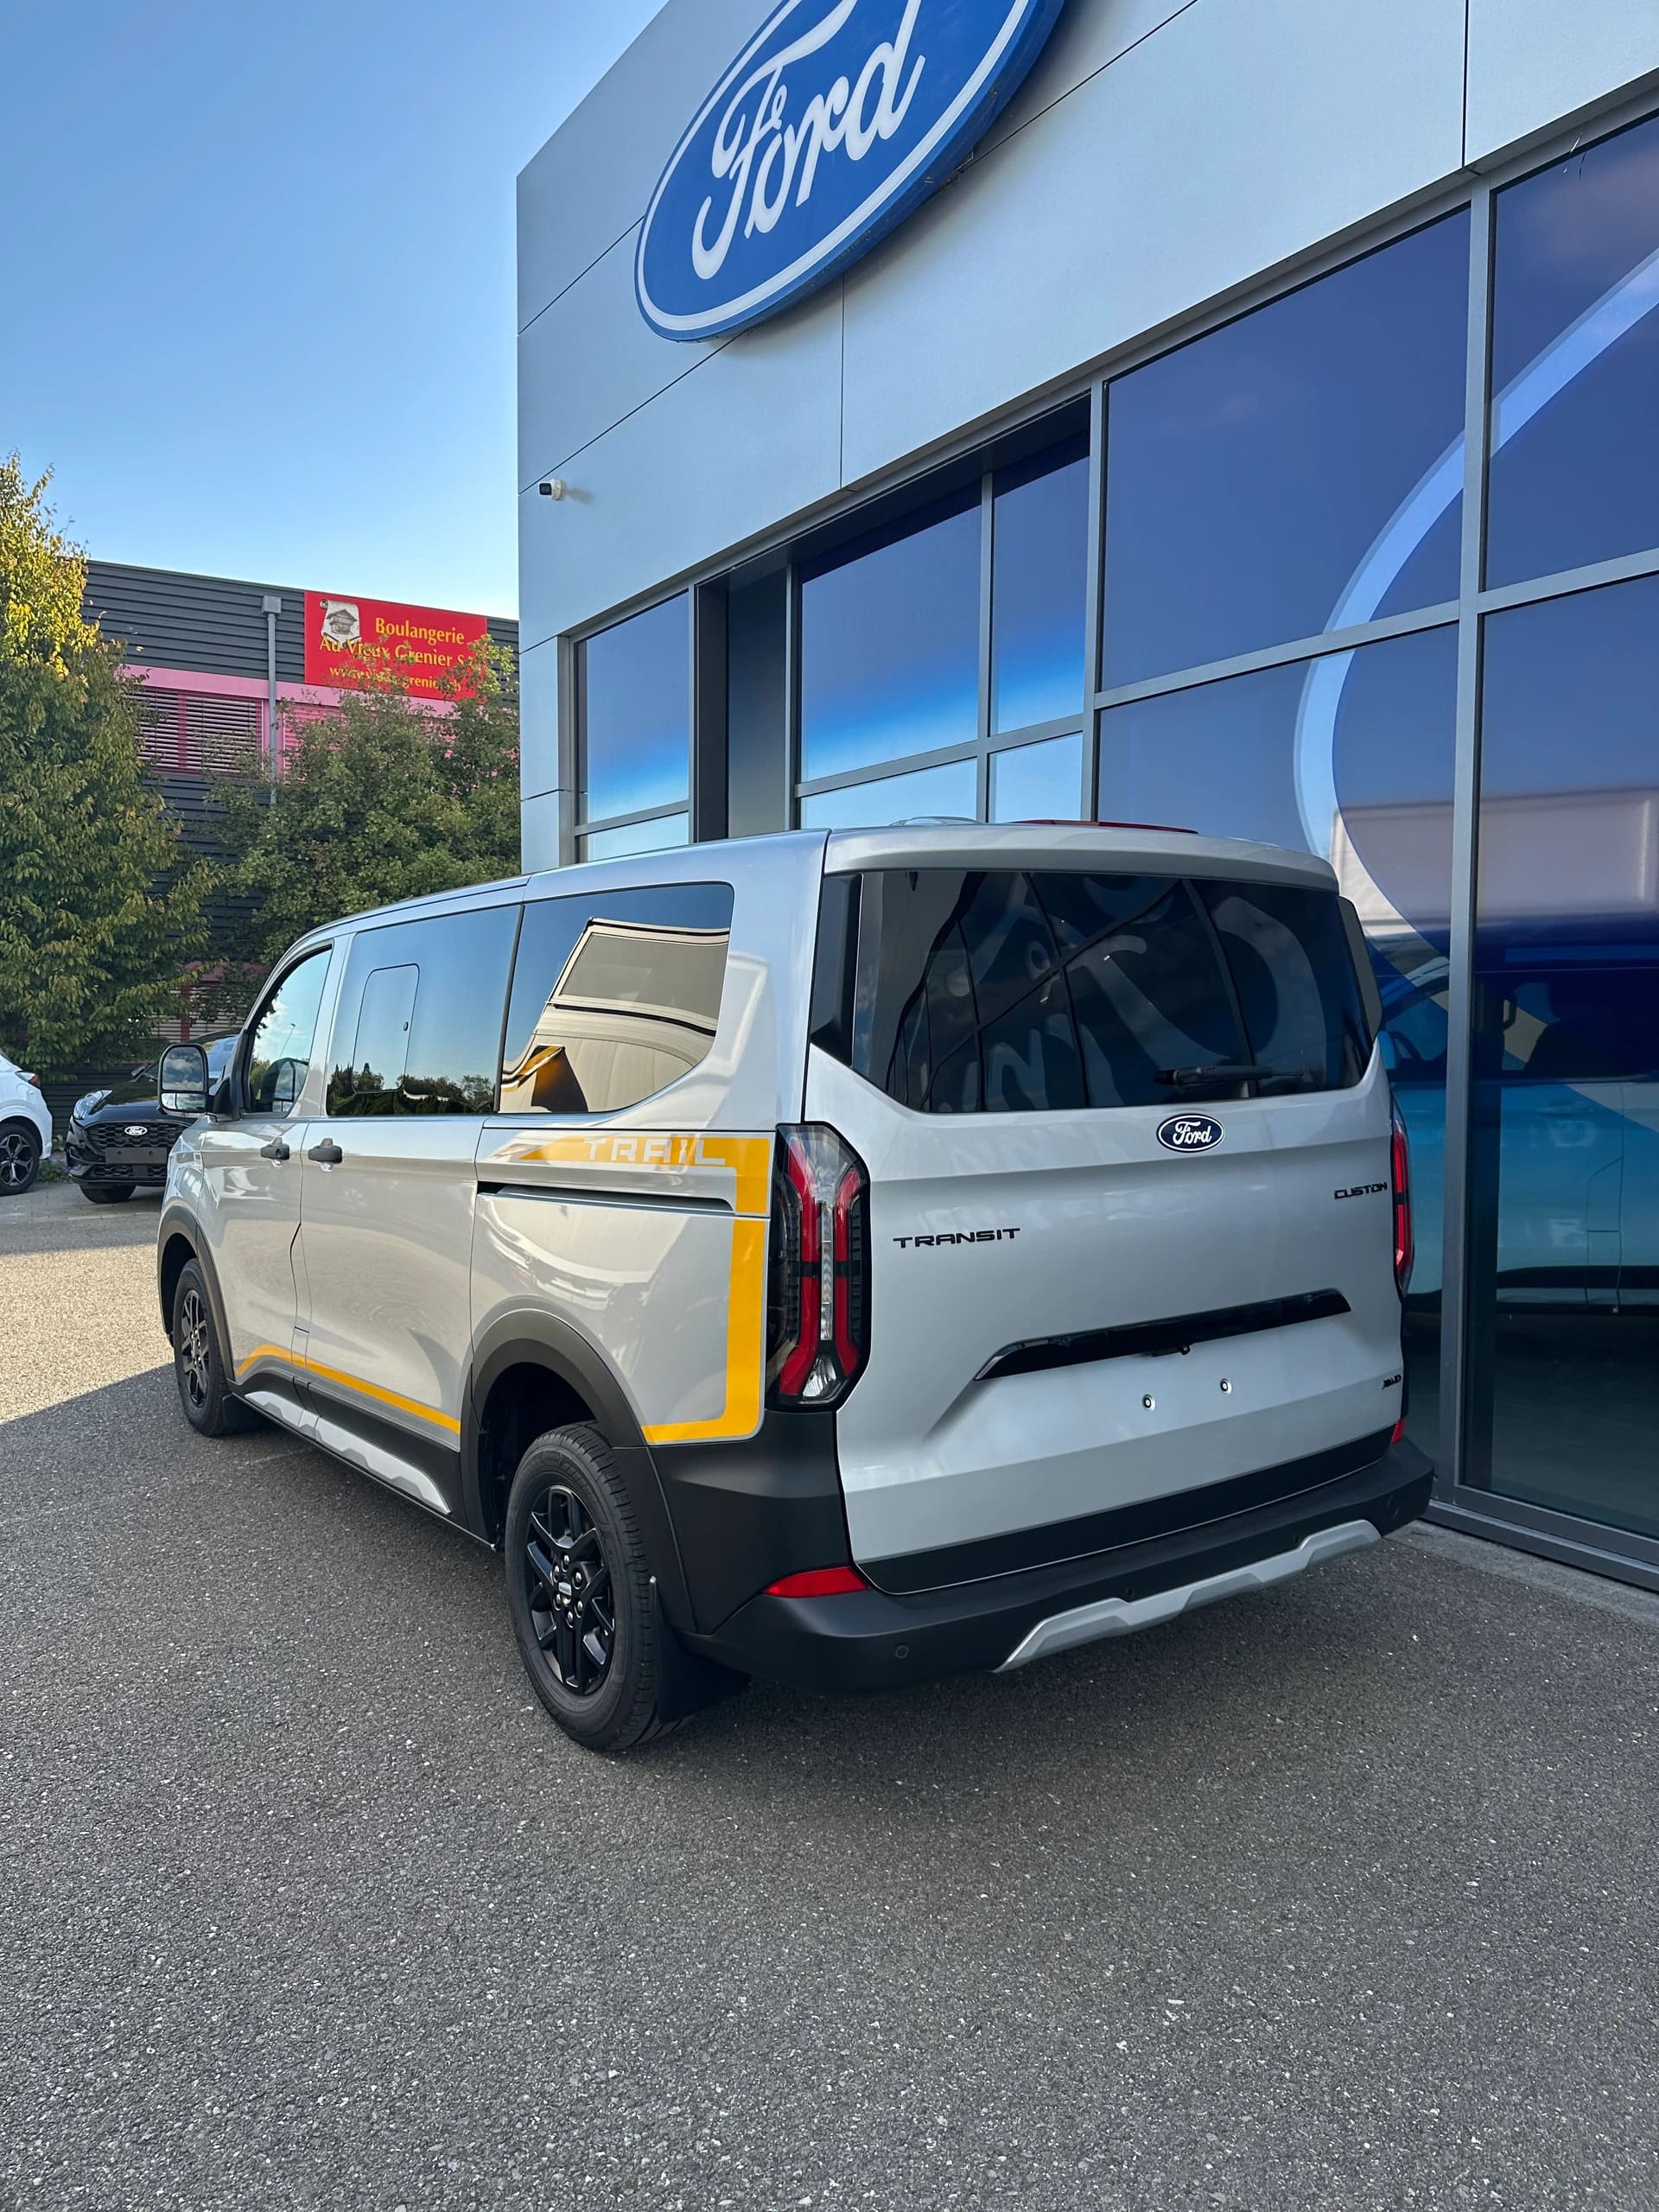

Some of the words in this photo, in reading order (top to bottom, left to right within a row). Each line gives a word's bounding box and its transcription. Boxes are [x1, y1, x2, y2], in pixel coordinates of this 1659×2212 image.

[692, 0, 925, 280] Ford
[375, 617, 465, 645] Boulangerie
[319, 636, 340, 653] Au
[1173, 1121, 1212, 1145] Ford
[583, 1137, 727, 1165] TRAIL
[1333, 1181, 1389, 1200] CUSTOM
[893, 1228, 1020, 1249] TRANSIT
